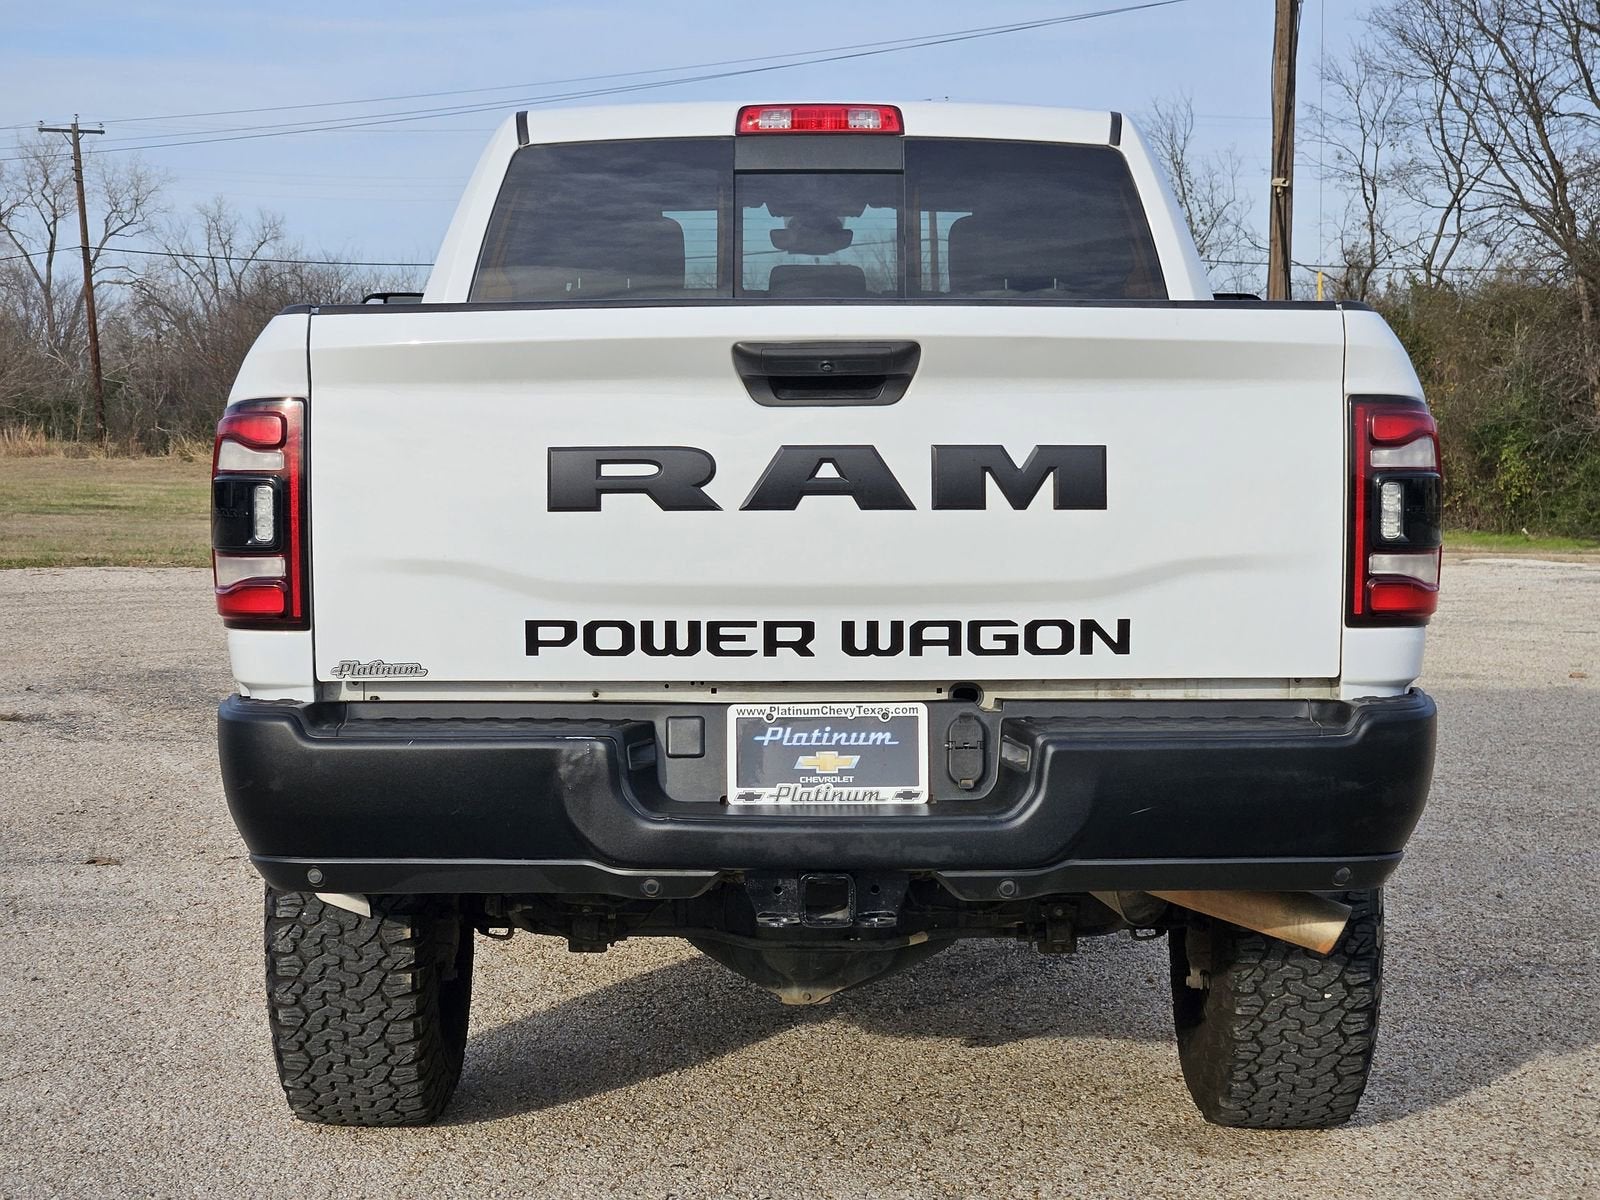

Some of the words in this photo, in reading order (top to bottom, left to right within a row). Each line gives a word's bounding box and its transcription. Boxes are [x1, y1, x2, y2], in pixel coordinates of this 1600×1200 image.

[547, 445, 1107, 511] RAM
[525, 620, 815, 657] POWER
[842, 618, 1131, 656] WAGON
[331, 660, 428, 679] Platinum
[736, 705, 919, 718] wwwPlatinumChevyTexas.com
[753, 726, 899, 746] Platinum
[768, 785, 887, 802] Platinum
